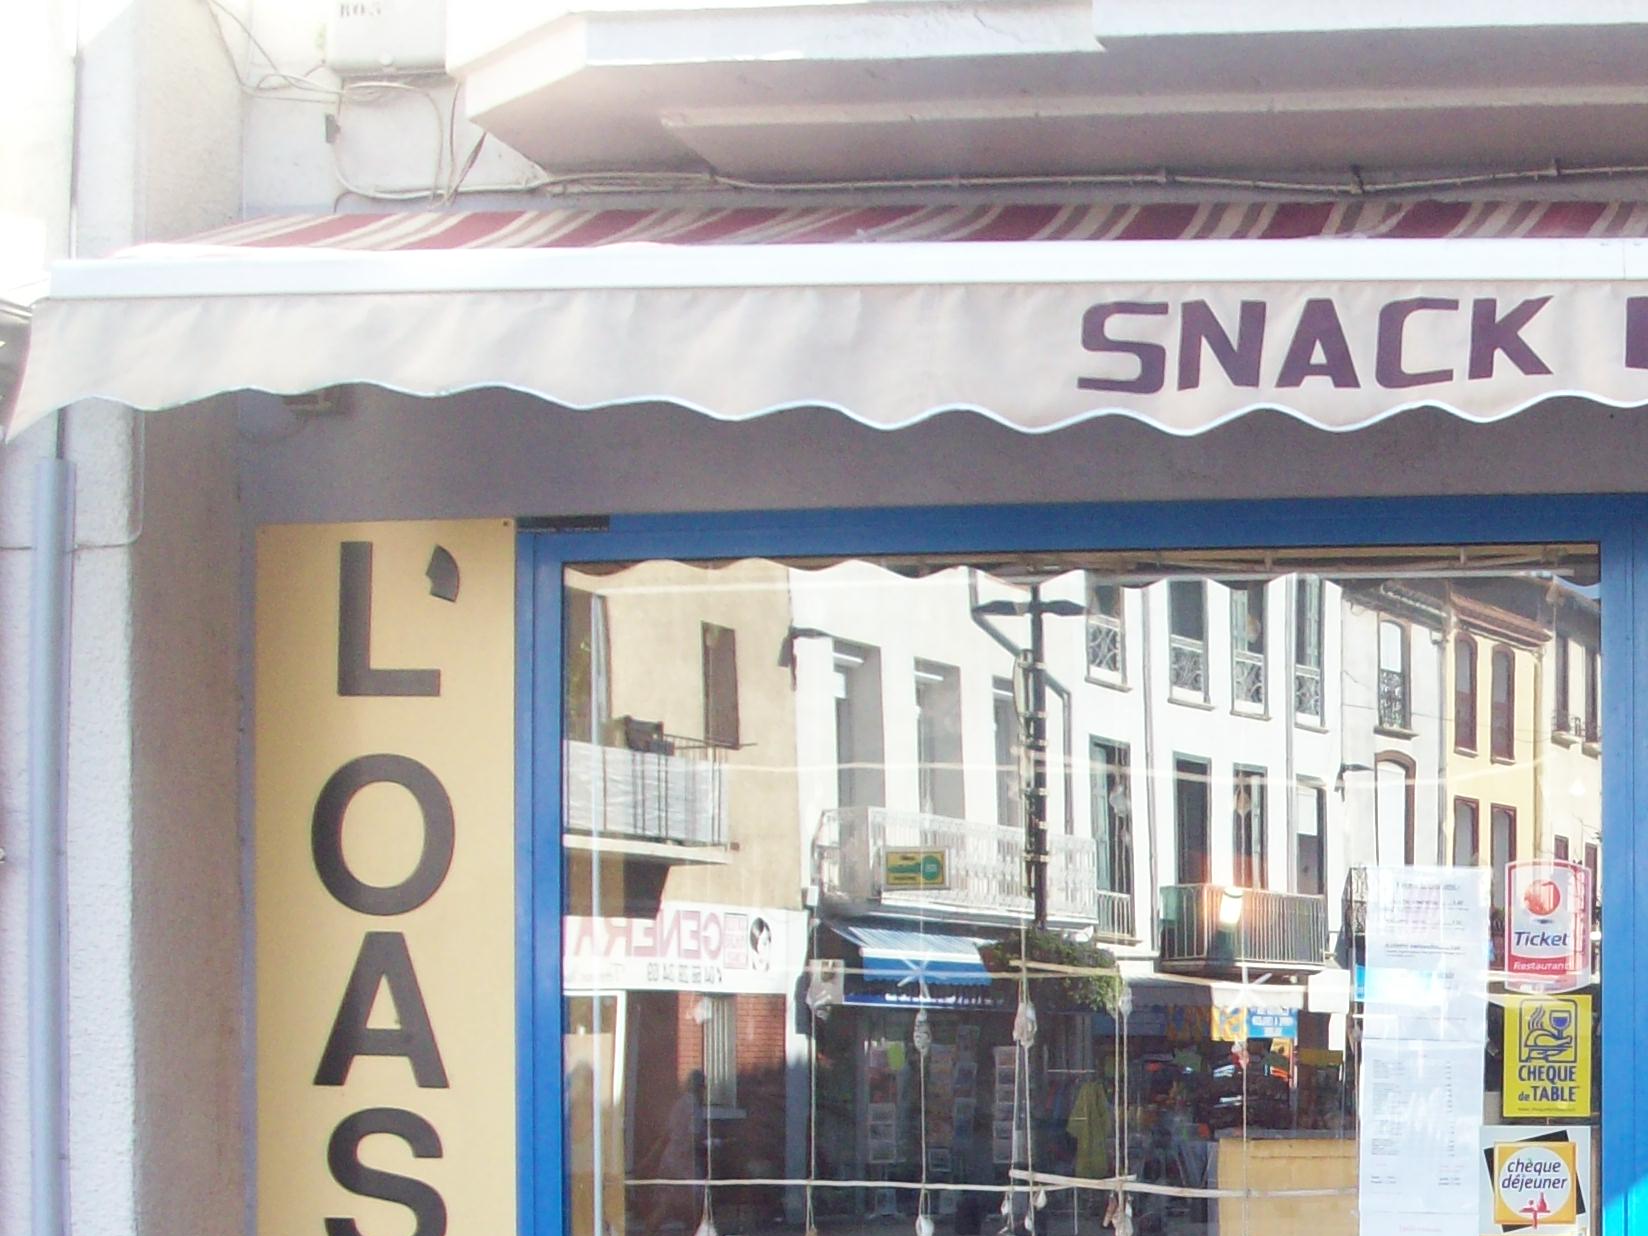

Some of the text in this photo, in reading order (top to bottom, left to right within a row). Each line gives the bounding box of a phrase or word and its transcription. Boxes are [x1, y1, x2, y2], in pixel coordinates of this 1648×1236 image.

[1076, 294, 1554, 394] SNACK
[1514, 930, 1571, 947] Ticket
[1518, 1065, 1577, 1083] CHEQUE
[1518, 1085, 1576, 1102] de TABLE
[1506, 1156, 1562, 1177] chèque
[1500, 1173, 1568, 1193] déjeuner
